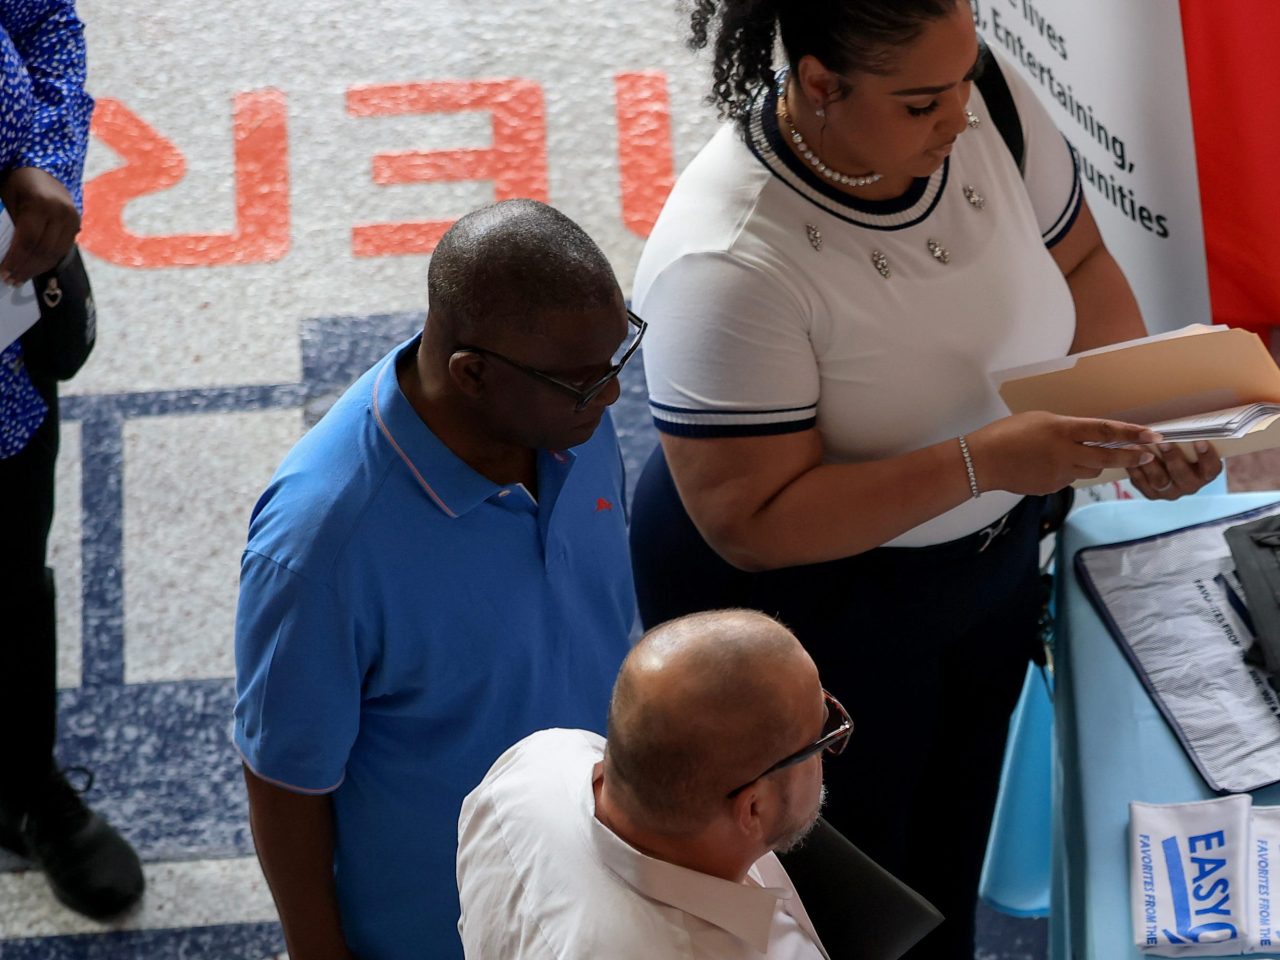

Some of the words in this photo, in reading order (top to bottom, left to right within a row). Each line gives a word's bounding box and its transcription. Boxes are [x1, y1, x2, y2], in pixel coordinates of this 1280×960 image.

[991, 7, 1134, 173] Entertaining,
[1139, 834, 1155, 892] FAVORITES
[1188, 830, 1231, 916] EASY
[1256, 839, 1269, 897] FAVORITES
[1144, 894, 1157, 923] FROM
[1258, 899, 1271, 927] FROM
[1146, 925, 1158, 945] THE
[1260, 928, 1271, 946] THE
